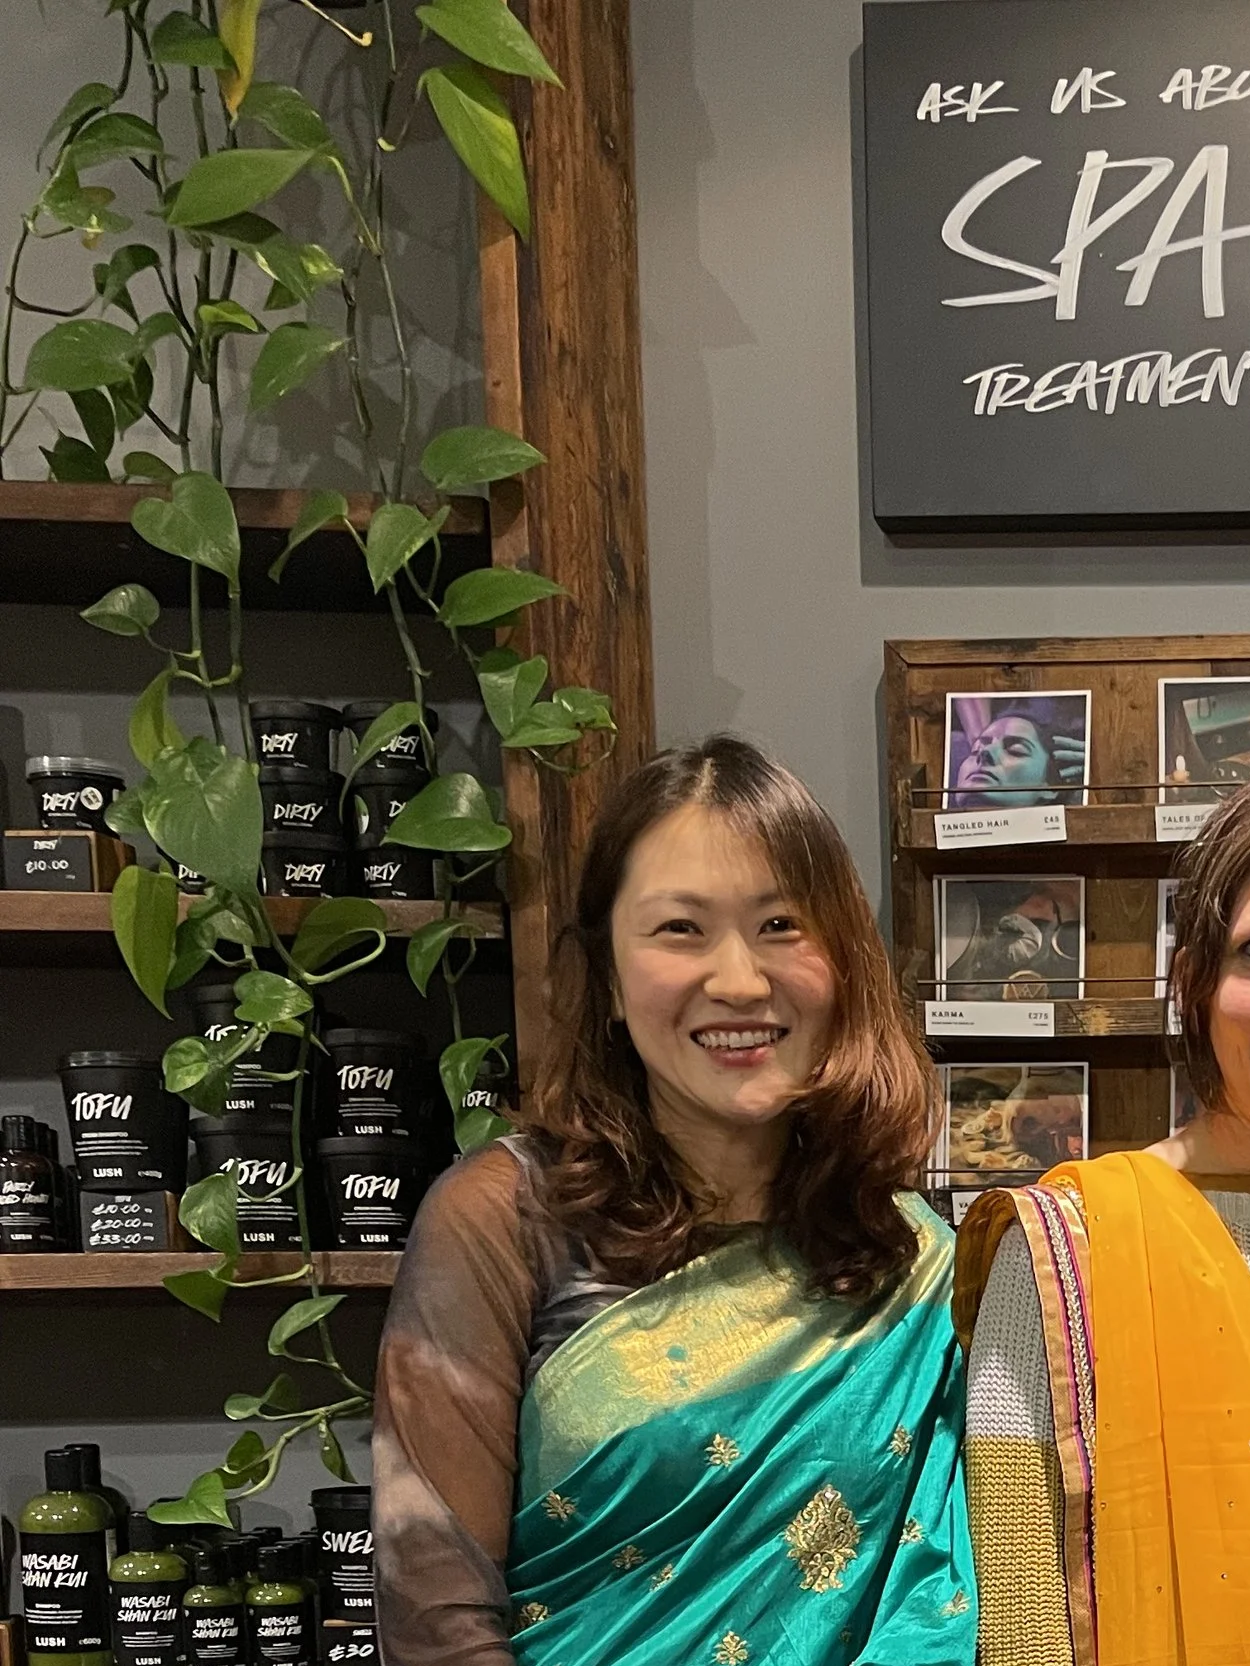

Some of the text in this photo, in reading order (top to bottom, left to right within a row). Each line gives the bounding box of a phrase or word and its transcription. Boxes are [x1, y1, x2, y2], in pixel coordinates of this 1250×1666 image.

[917, 81, 1019, 122] ASK
[1051, 68, 1126, 113] US
[261, 732, 298, 752] DIRTY
[42, 792, 80, 811] DIRTY
[274, 803, 323, 821] DIRTY
[942, 820, 984, 832] TANGLED
[1162, 815, 1191, 824] TALES
[285, 863, 326, 882] DIRTY
[364, 862, 401, 881] DIRTY
[337, 1065, 394, 1091] TOFU
[71, 1092, 132, 1121] TOFU
[226, 1100, 255, 1110] LUSH
[355, 1125, 383, 1135] LUSH
[93, 1168, 122, 1178] LUSH
[219, 1158, 287, 1186] TOFU
[341, 1174, 400, 1200] TOFU
[243, 1233, 275, 1243] LUSH
[360, 1234, 389, 1243] LUSH
[22, 1553, 79, 1571] WASABI
[21, 1570, 88, 1588] SHAN KUI
[121, 1595, 171, 1609] WASABI
[344, 1598, 373, 1607] LUSH
[117, 1608, 177, 1622] SHAN KUI
[261, 1616, 299, 1627] WASABI
[196, 1618, 235, 1629] WASABI
[192, 1627, 220, 1639] SHAN
[257, 1626, 286, 1637] SHAN
[35, 1636, 66, 1647] LUSH
[135, 1657, 162, 1666] LUSH
